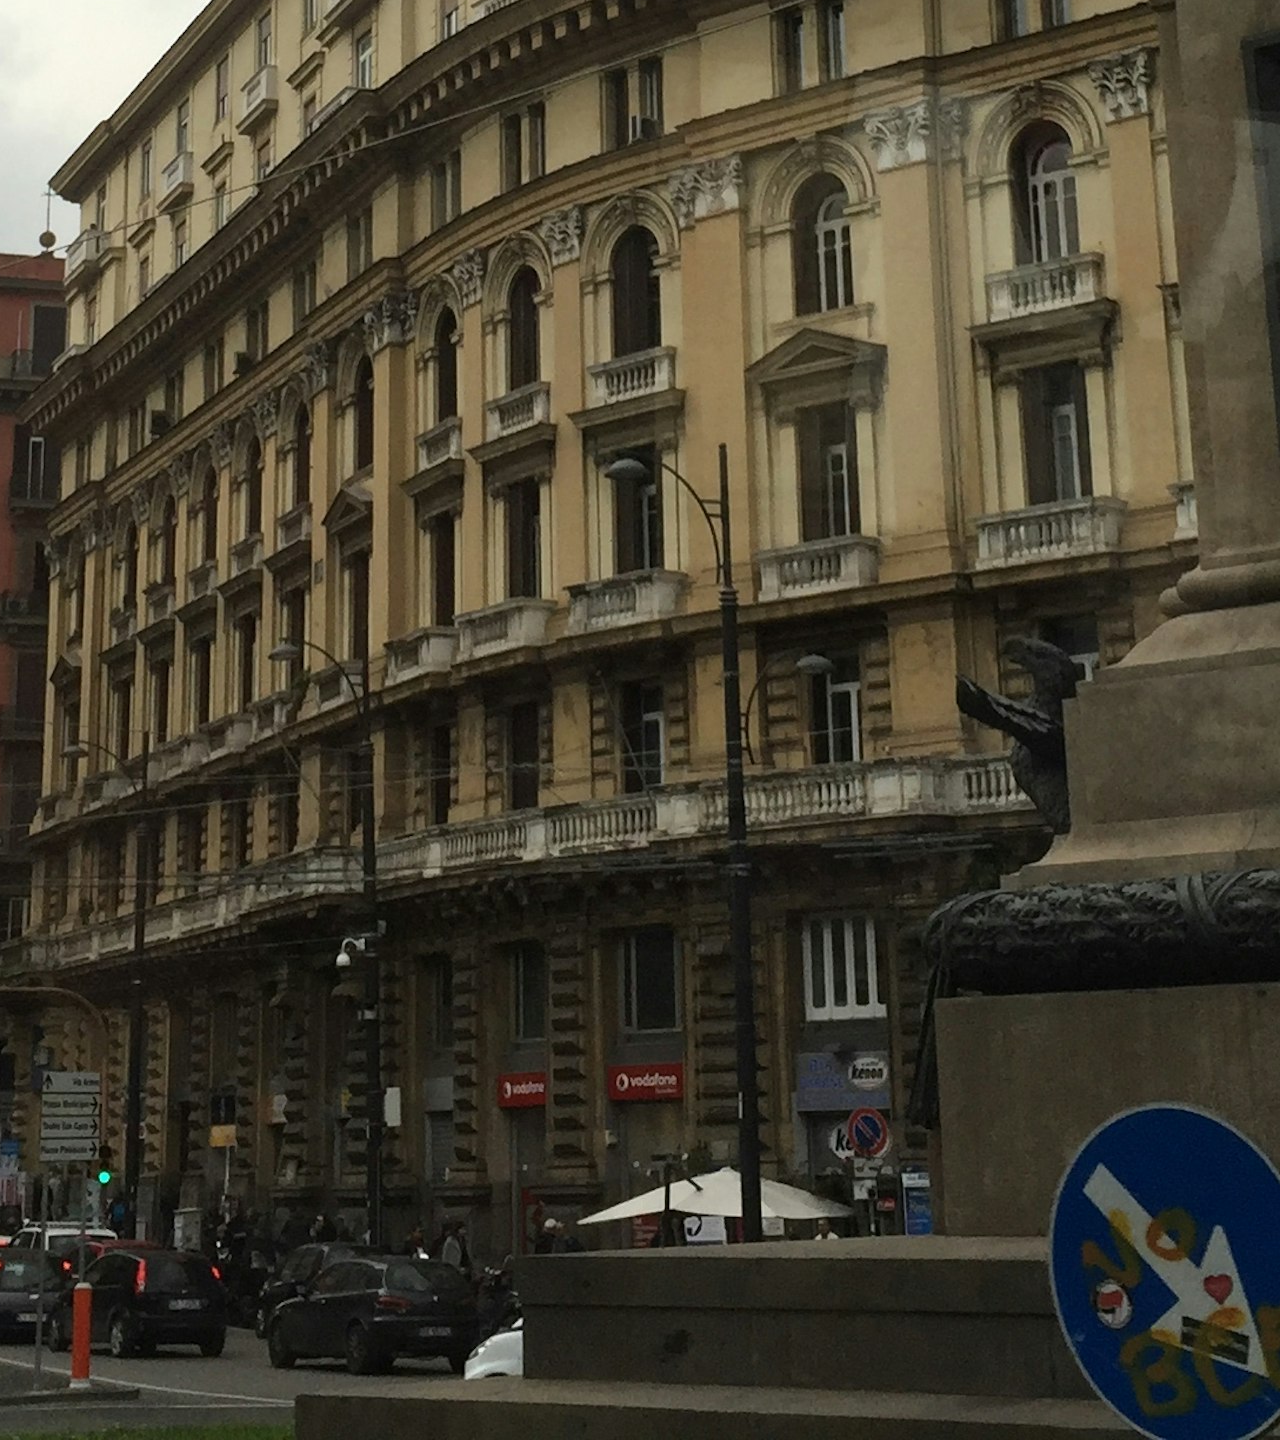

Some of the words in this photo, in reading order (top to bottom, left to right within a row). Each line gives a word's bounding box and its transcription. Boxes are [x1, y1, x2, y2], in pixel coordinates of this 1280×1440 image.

[629, 1072, 678, 1088] vodafone
[851, 1064, 884, 1080] kenon
[511, 1081, 545, 1095] vodafone
